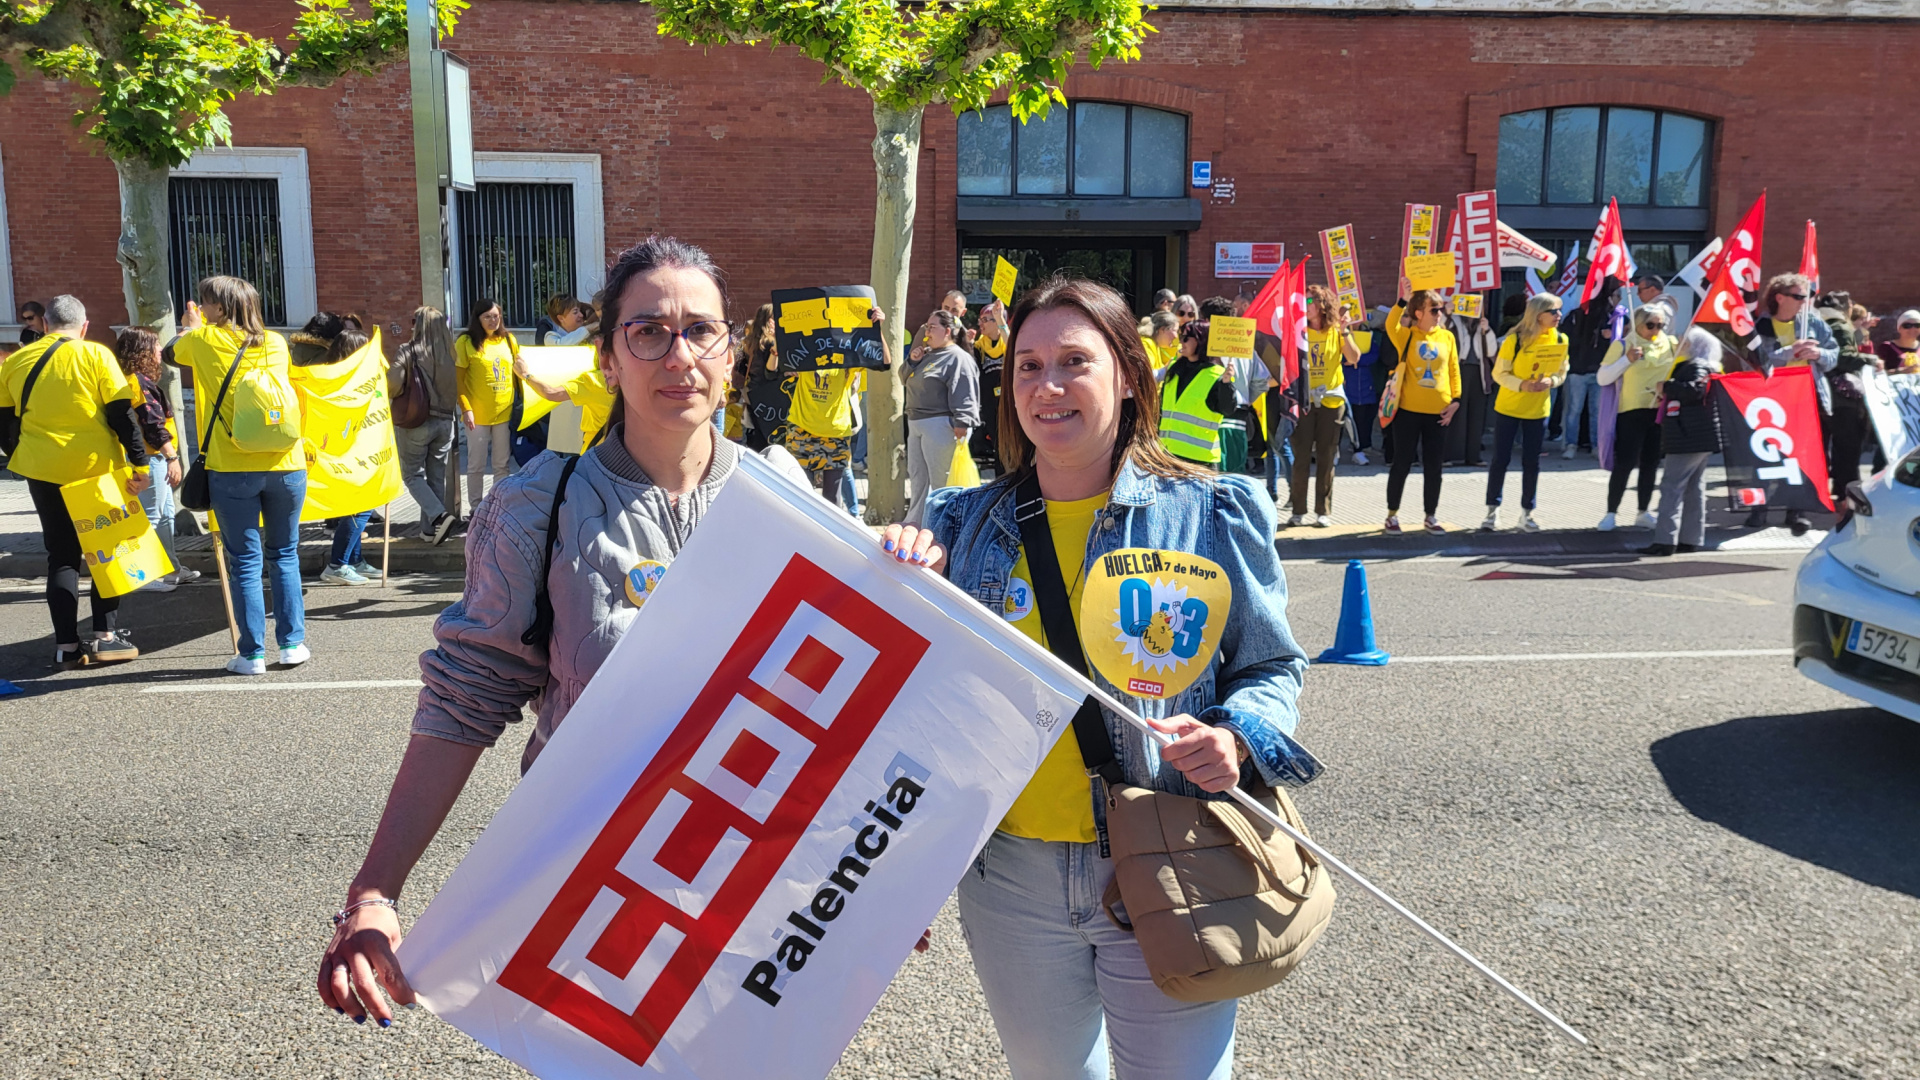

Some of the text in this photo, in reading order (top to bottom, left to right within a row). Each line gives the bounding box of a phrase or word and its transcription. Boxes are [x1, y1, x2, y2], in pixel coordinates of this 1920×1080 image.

[1465, 193, 1494, 289] CCOO
[783, 306, 866, 322] EDUCAR CUIDAR
[784, 339, 811, 370] VAN
[815, 336, 833, 352] DE
[838, 337, 852, 350] LA
[1745, 396, 1803, 486] CGT
[1103, 551, 1217, 580] HUELGA 7 de Mayo
[1861, 628, 1909, 665] 5734
[1129, 679, 1163, 694] CCOO
[547, 600, 881, 1017] CCOO
[741, 776, 926, 1008] Palencia
